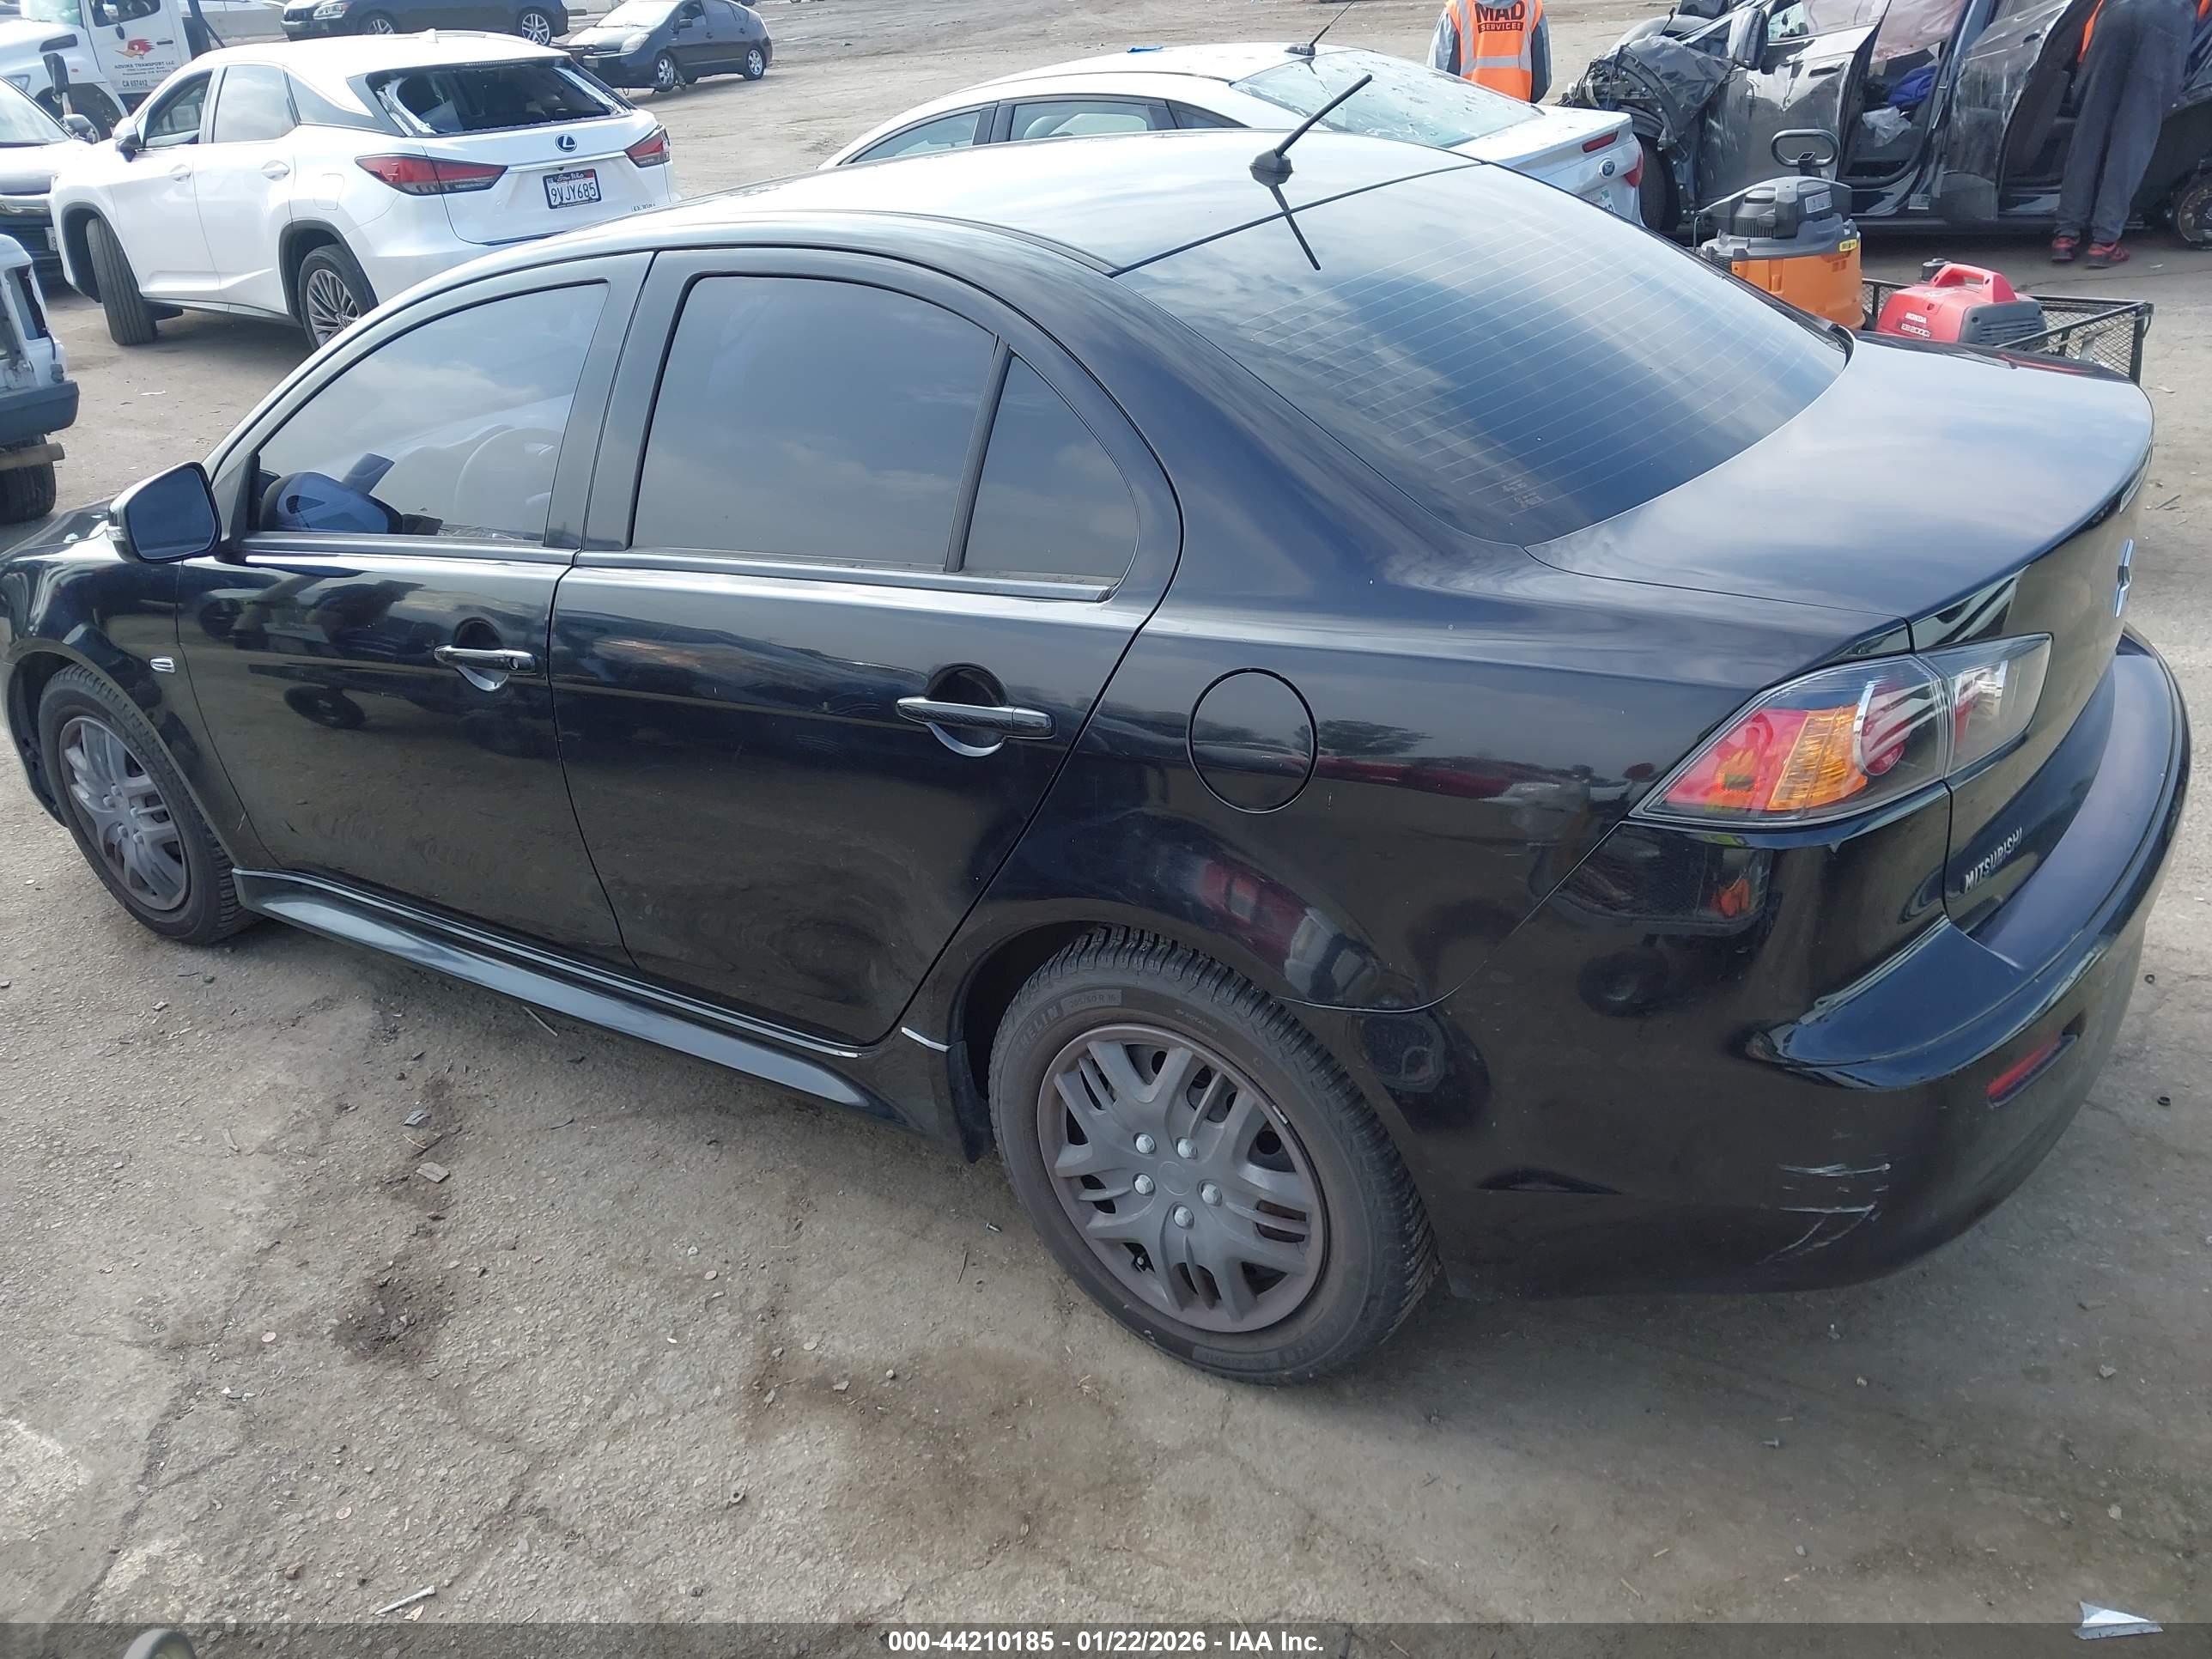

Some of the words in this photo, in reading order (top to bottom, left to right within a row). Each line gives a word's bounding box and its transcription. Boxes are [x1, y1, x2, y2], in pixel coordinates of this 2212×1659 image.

[1474, 1, 1526, 23] MAD
[1480, 22, 1522, 32] SERVICES
[550, 181, 597, 204] 9VJY685
[1964, 827, 2023, 894] MITSUBISHI
